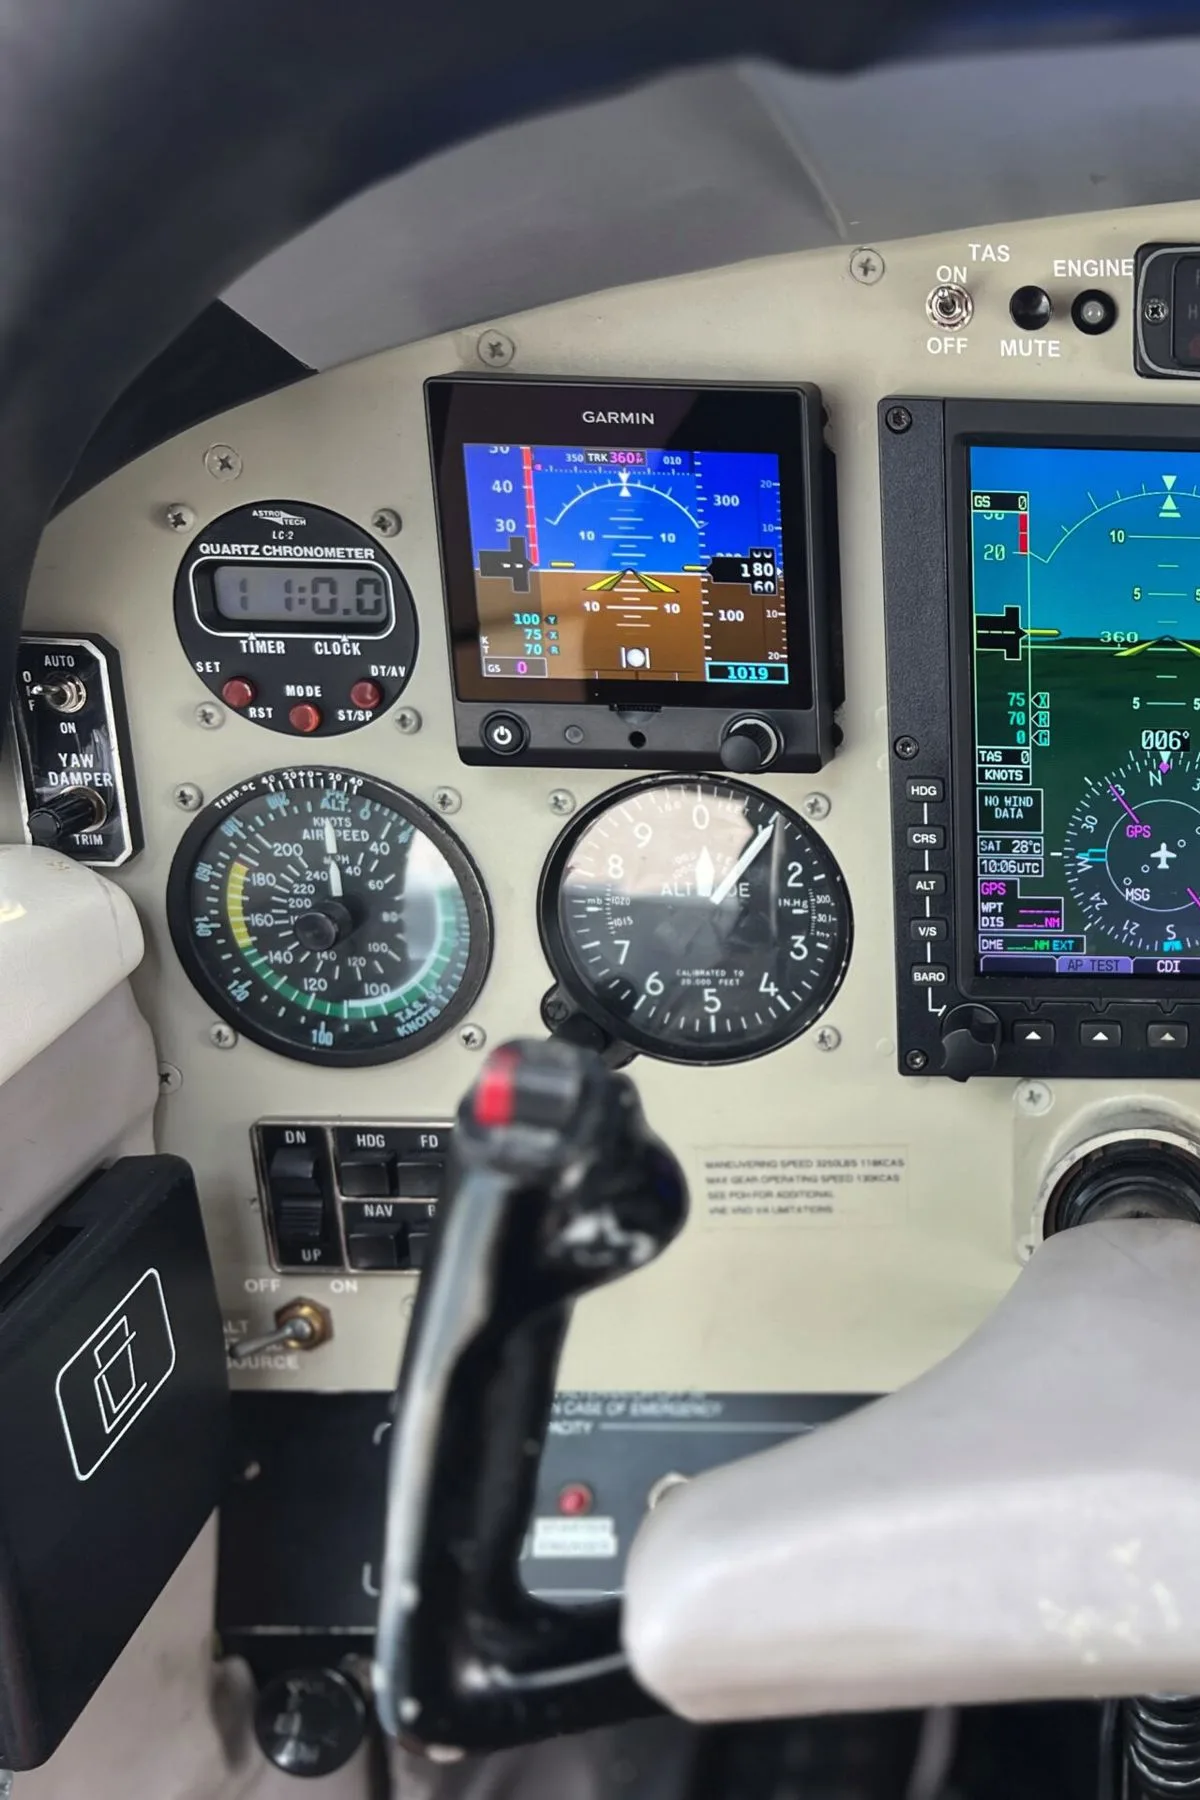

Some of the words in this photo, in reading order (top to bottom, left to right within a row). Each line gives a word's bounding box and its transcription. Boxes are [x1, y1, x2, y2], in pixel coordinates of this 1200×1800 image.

[969, 244, 1010, 261] TAS
[936, 265, 967, 283] ON
[1053, 259, 1134, 278] ENGINE
[927, 337, 968, 355] OFF
[1000, 339, 1061, 358] MUTE
[581, 410, 655, 426] GARMIN
[713, 495, 740, 508] 300
[271, 530, 295, 541] LC-2
[199, 543, 260, 557] QUARTZ
[262, 545, 375, 560] CHRONOMETER
[718, 610, 745, 622] 100
[1099, 631, 1139, 644] 360
[240, 640, 285, 655] TIMER
[314, 640, 361, 656] CLOCK
[44, 654, 75, 668] AUTO
[195, 661, 221, 674] SET
[370, 664, 406, 678] DT/AV
[727, 666, 769, 681] 1019
[285, 684, 322, 698] MODE
[248, 707, 274, 719] RST
[337, 708, 373, 722] ST/SP
[60, 722, 77, 735] ON
[58, 753, 94, 768] YAW
[979, 750, 1002, 762] TAS
[48, 770, 113, 787] DAMPER
[984, 768, 1024, 782] KNOTS
[911, 784, 937, 797] HDG
[1004, 795, 1034, 808] WIND
[994, 807, 1024, 820] DATA
[1126, 824, 1151, 838] GPS
[73, 833, 104, 846] TRIM
[912, 833, 937, 845] CRS
[273, 843, 303, 857] 200
[980, 840, 1001, 852] SAT
[1011, 839, 1042, 854] 28°C
[251, 872, 277, 887] 180
[916, 879, 936, 891] ALT
[980, 882, 1006, 896] GPS
[1125, 888, 1150, 901] MSG
[981, 902, 1003, 914] WPT
[250, 913, 274, 927] 160
[981, 916, 1004, 928] DIS
[918, 926, 937, 938] V/S
[613, 940, 631, 965] 7
[789, 935, 809, 961] 3
[268, 950, 293, 965] 140
[1089, 959, 1120, 972] TEST
[1156, 961, 1181, 973] CDI
[645, 971, 665, 996] 6
[913, 971, 945, 983] BARO
[303, 978, 328, 991] 120
[703, 988, 722, 1013] 5
[285, 1130, 307, 1144] DN
[356, 1134, 386, 1148] HDG
[364, 1204, 393, 1218] NAV
[244, 1278, 281, 1294] OFF
[330, 1279, 358, 1293] ON
